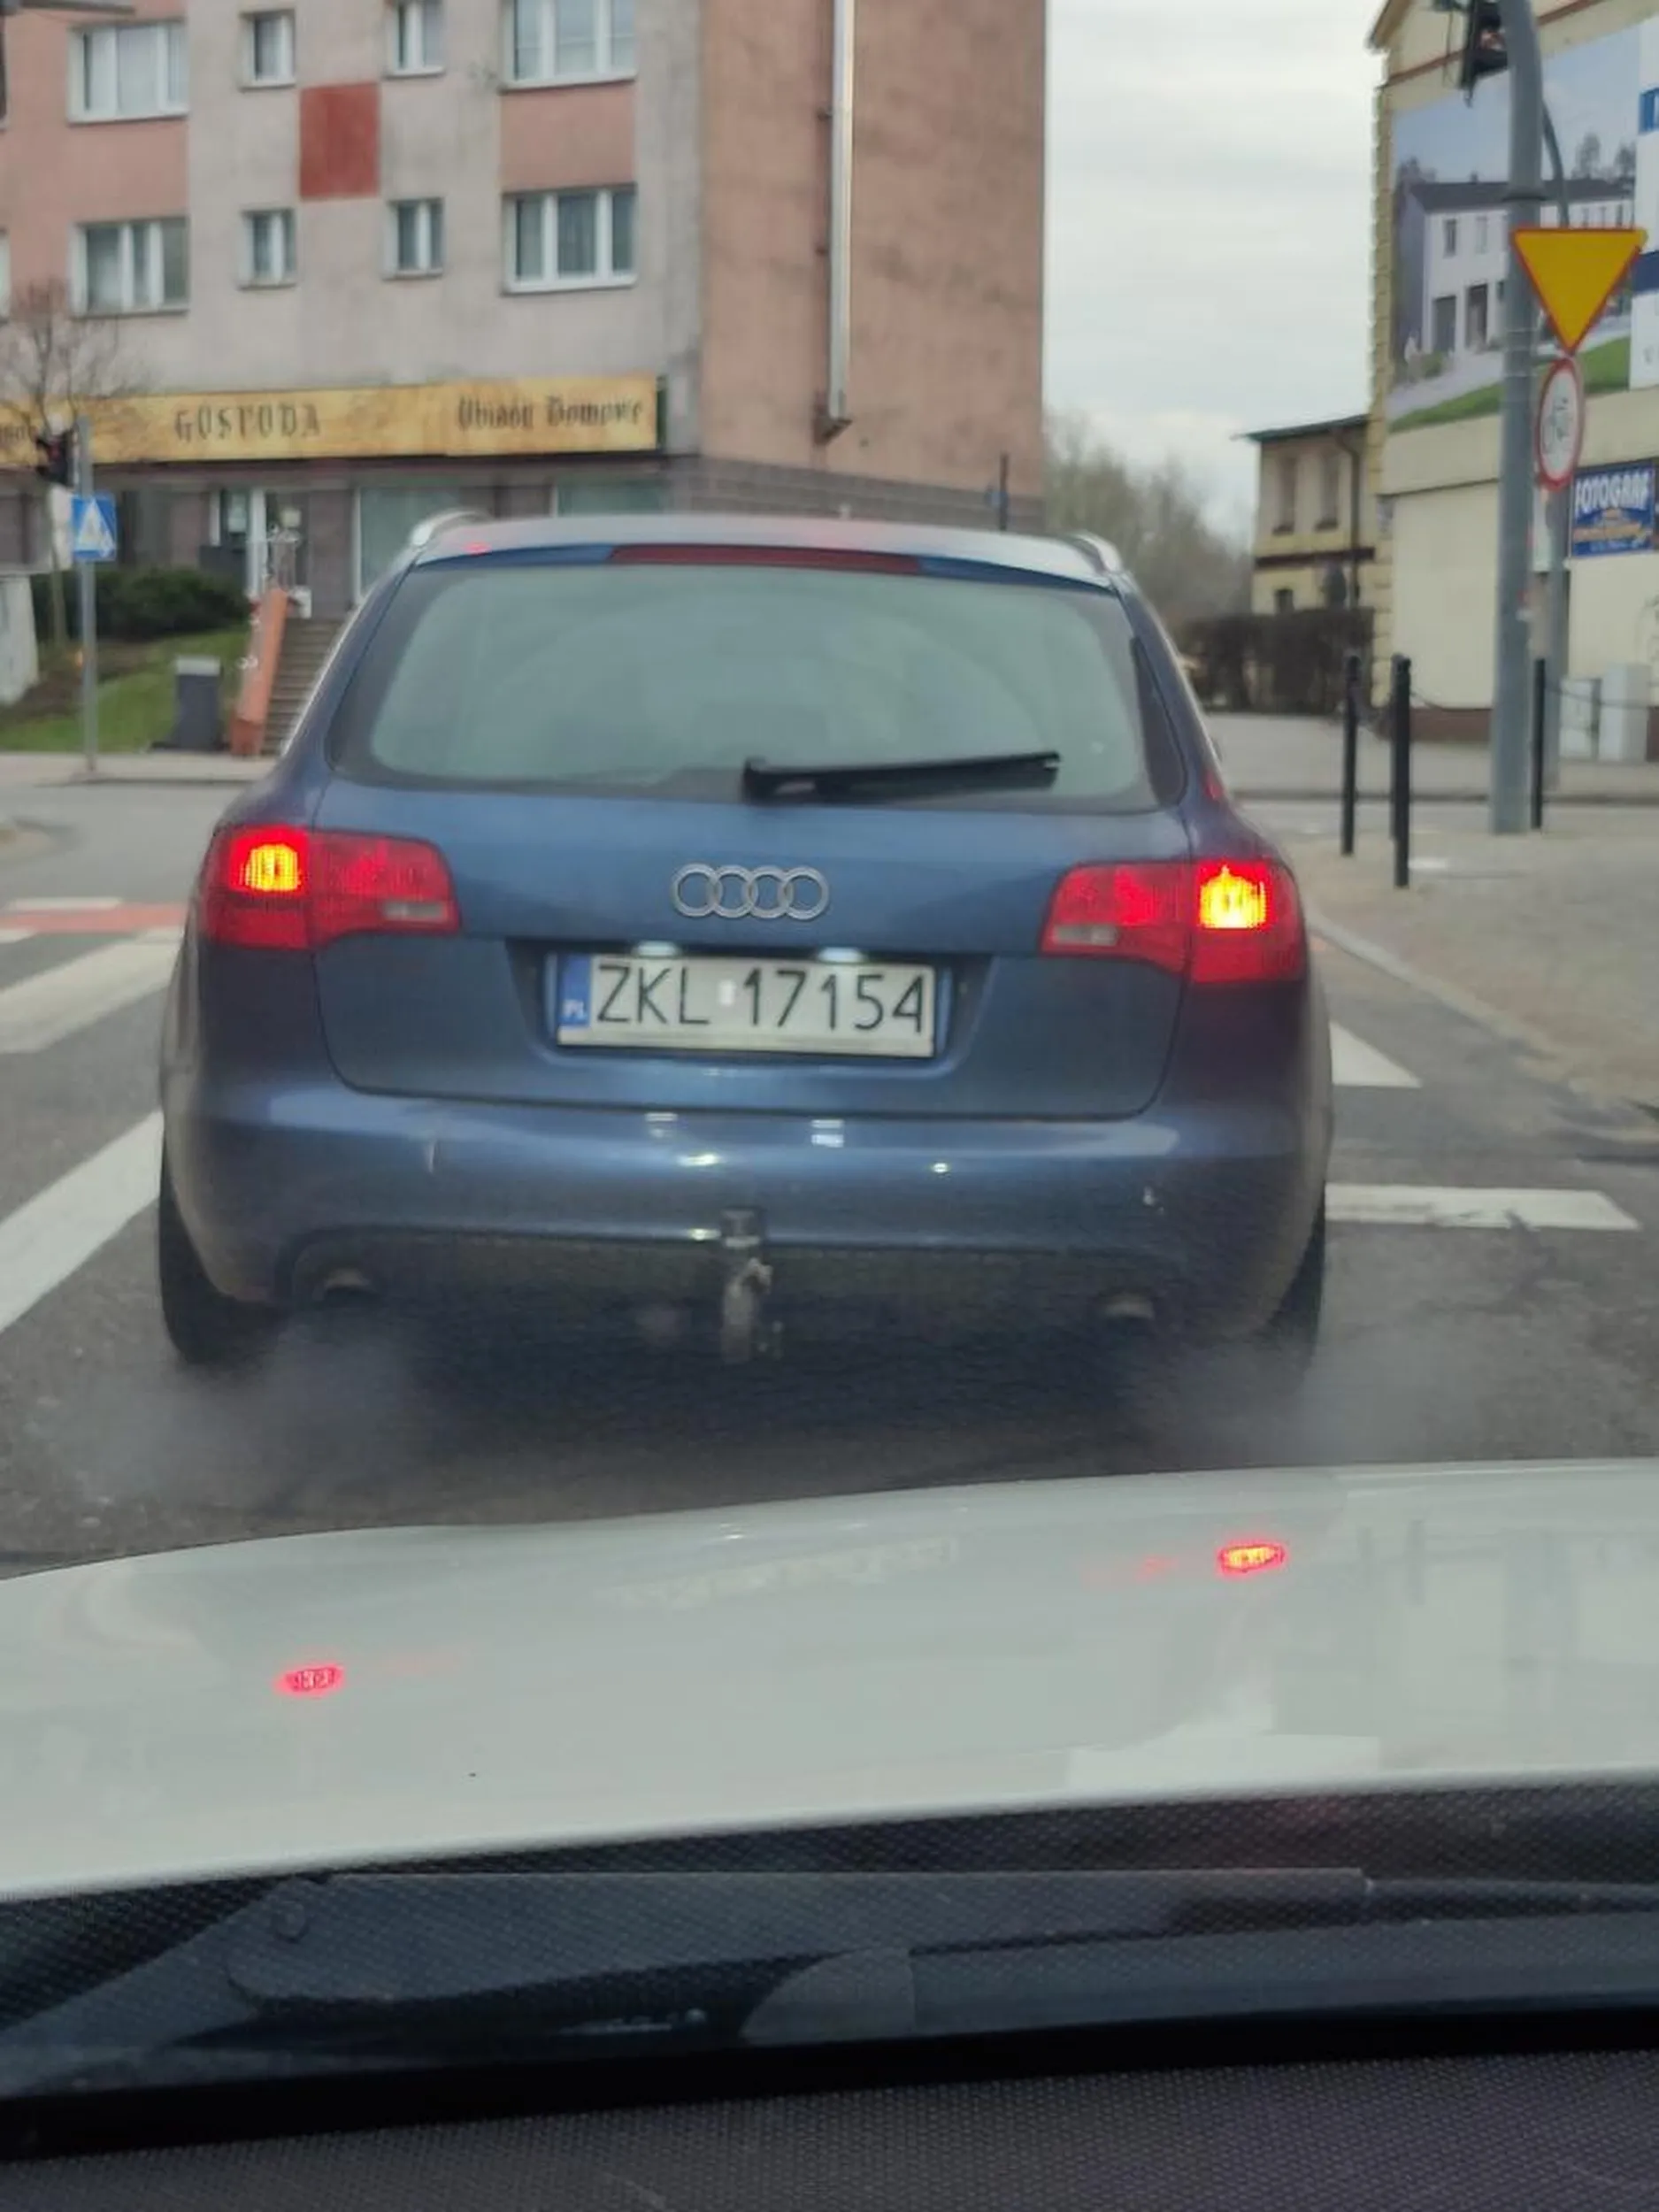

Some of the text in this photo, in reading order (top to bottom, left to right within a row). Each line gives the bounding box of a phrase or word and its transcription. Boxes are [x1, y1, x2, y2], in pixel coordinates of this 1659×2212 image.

[1575, 470, 1649, 518] FOTOGRAF
[597, 964, 924, 1033] ZKL 17154
